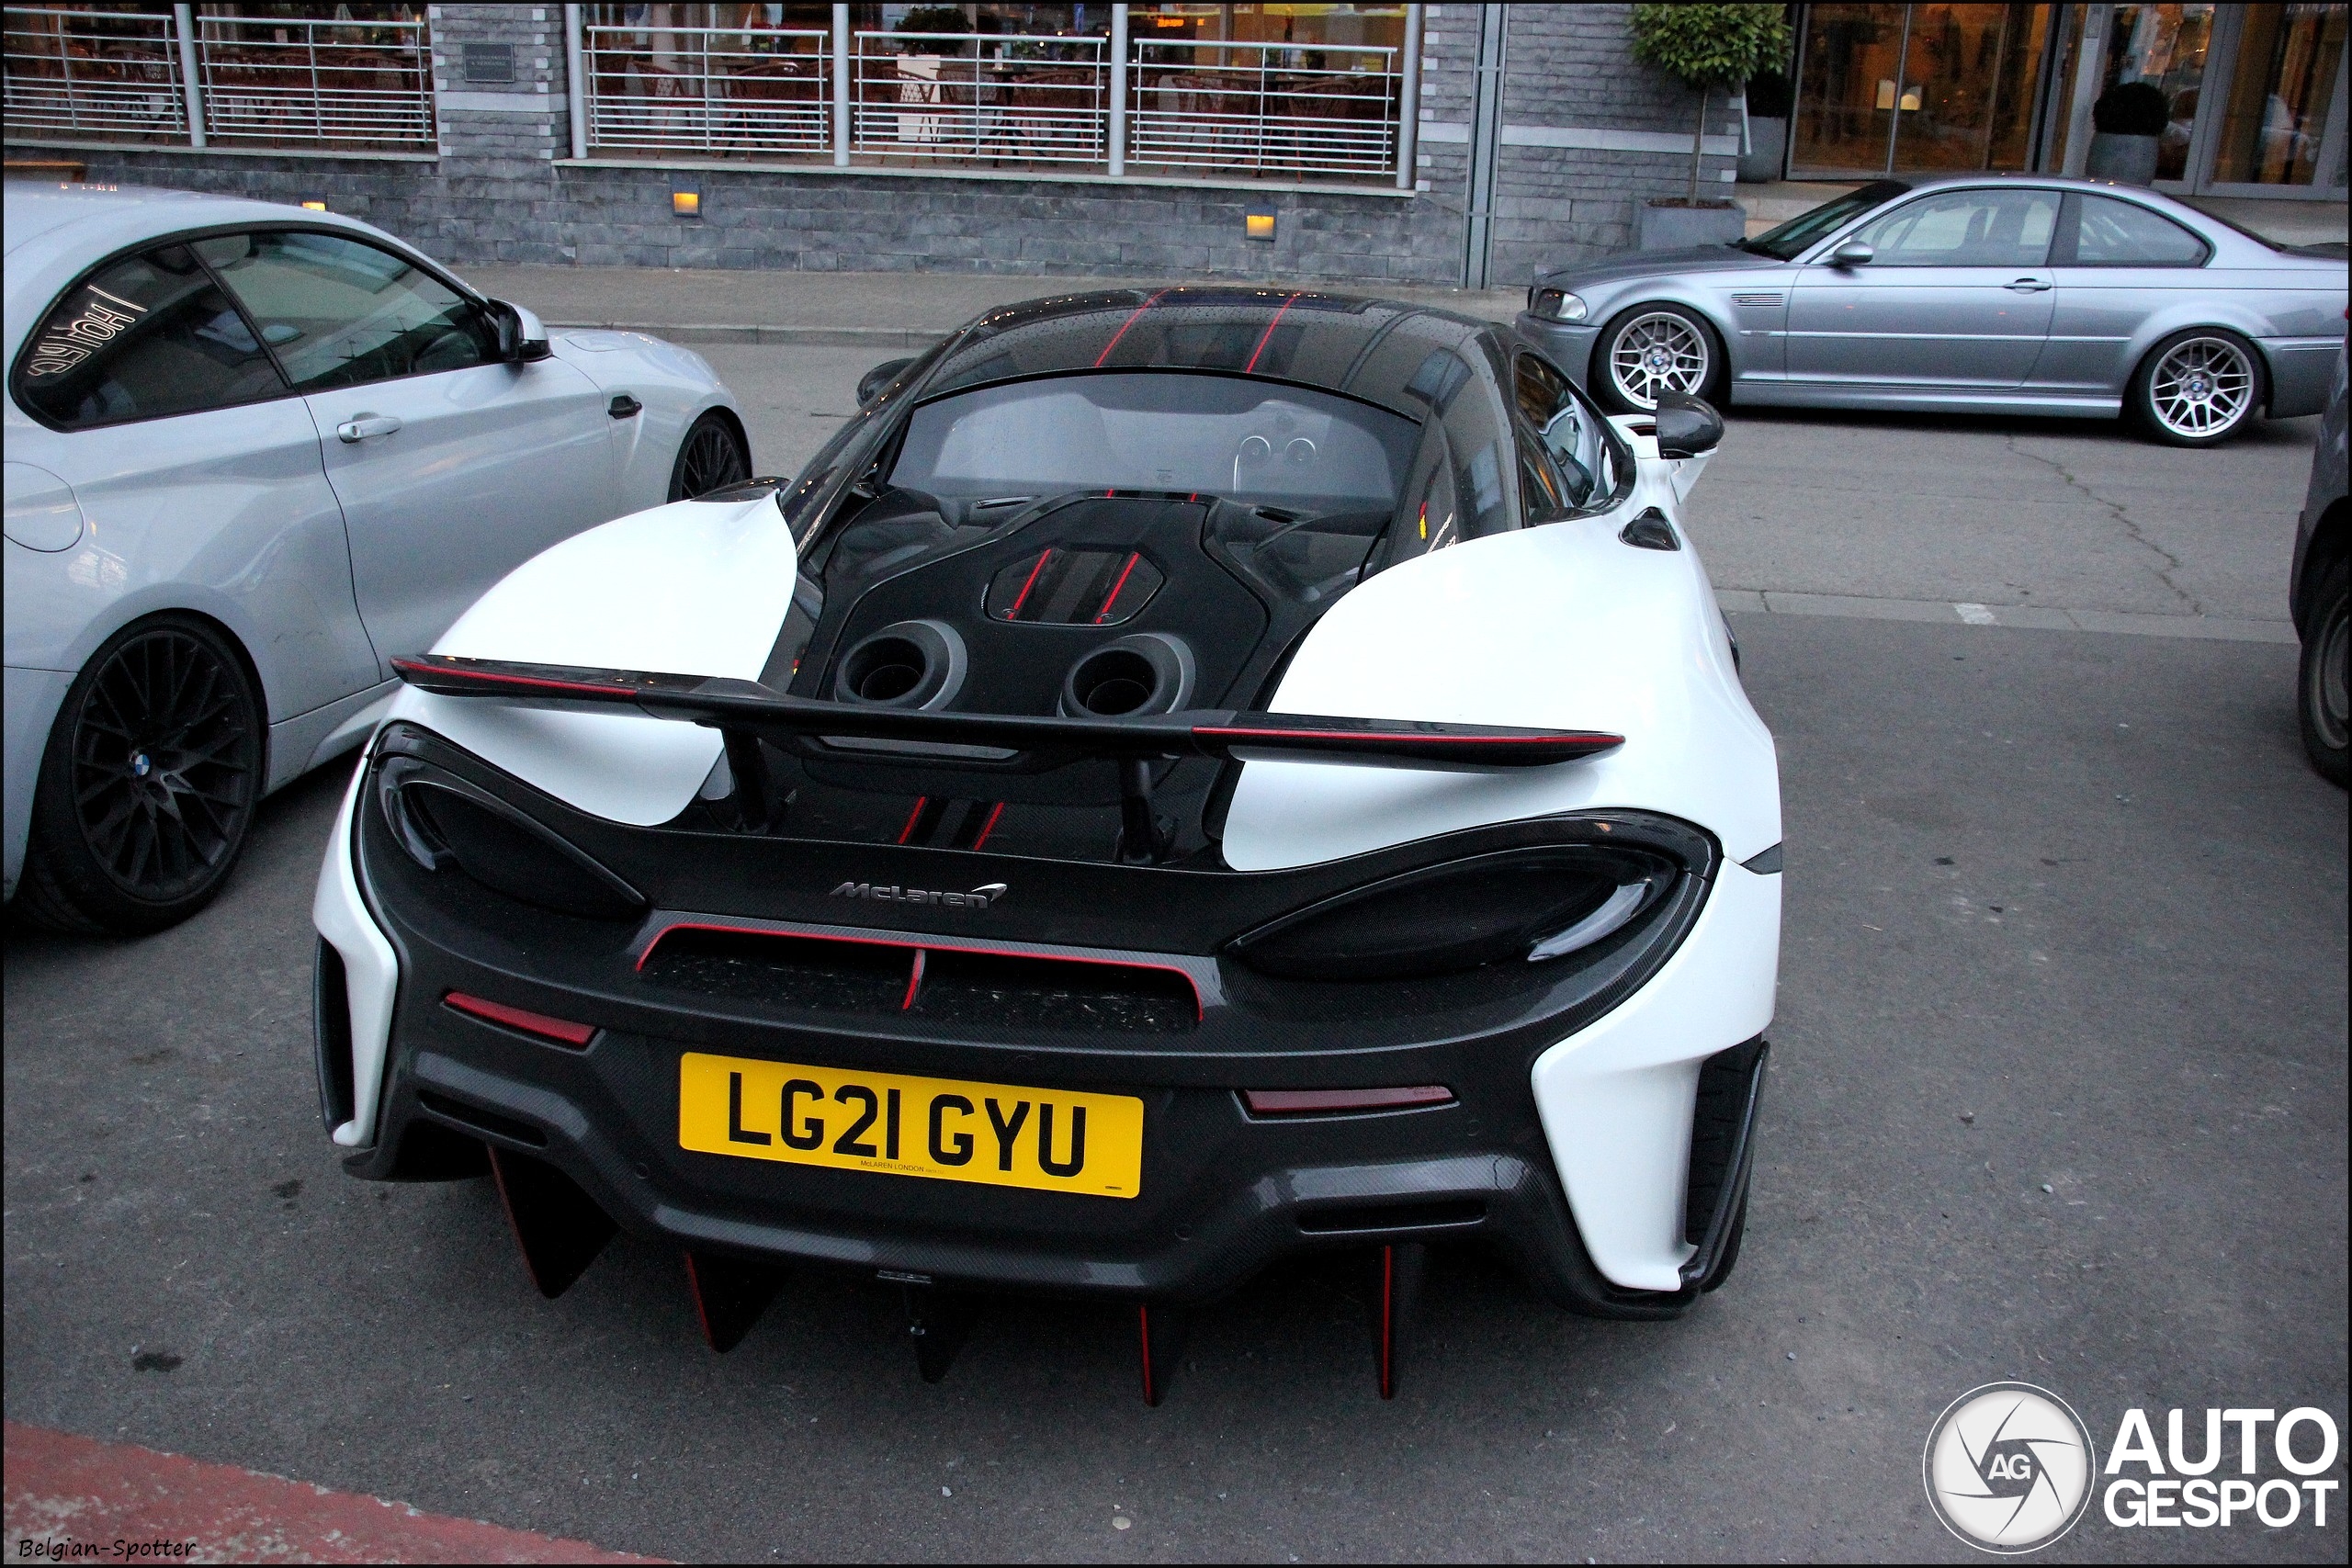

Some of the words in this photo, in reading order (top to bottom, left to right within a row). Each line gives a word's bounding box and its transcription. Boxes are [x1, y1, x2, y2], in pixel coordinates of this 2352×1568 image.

[829, 882, 989, 908] McLaren
[729, 1071, 900, 1160] LG21
[928, 1093, 1087, 1178] GYU
[860, 1160, 893, 1169] McLAREN
[894, 1164, 924, 1172] LONDON
